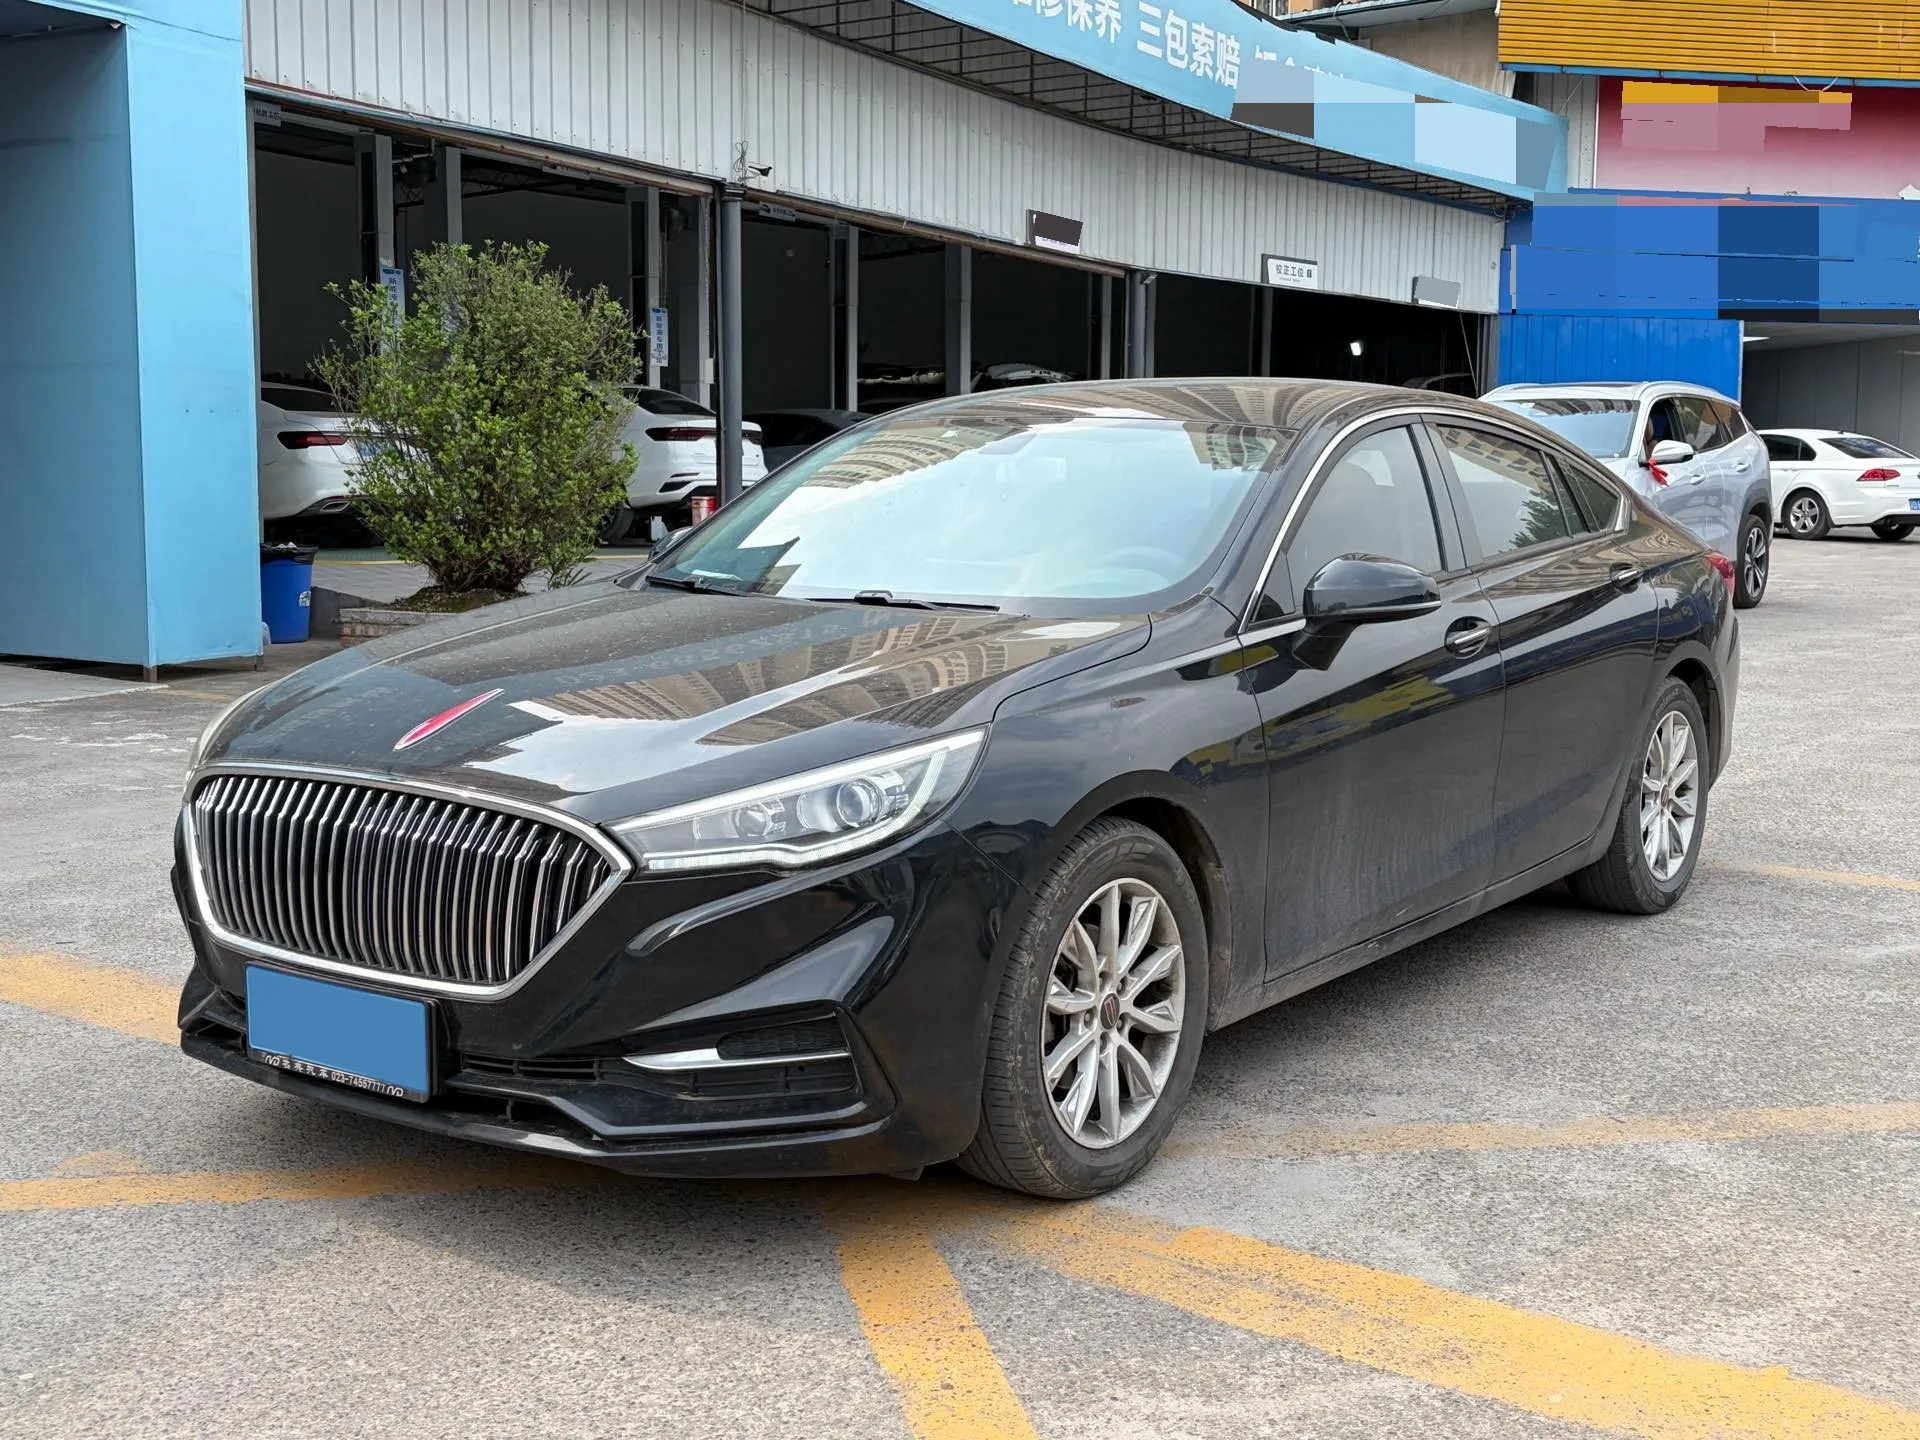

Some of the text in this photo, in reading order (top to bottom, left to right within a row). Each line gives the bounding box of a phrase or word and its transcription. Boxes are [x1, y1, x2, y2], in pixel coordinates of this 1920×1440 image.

[1012, 0, 1121, 43] 保养
[1137, 3, 1241, 90] 三包索赔
